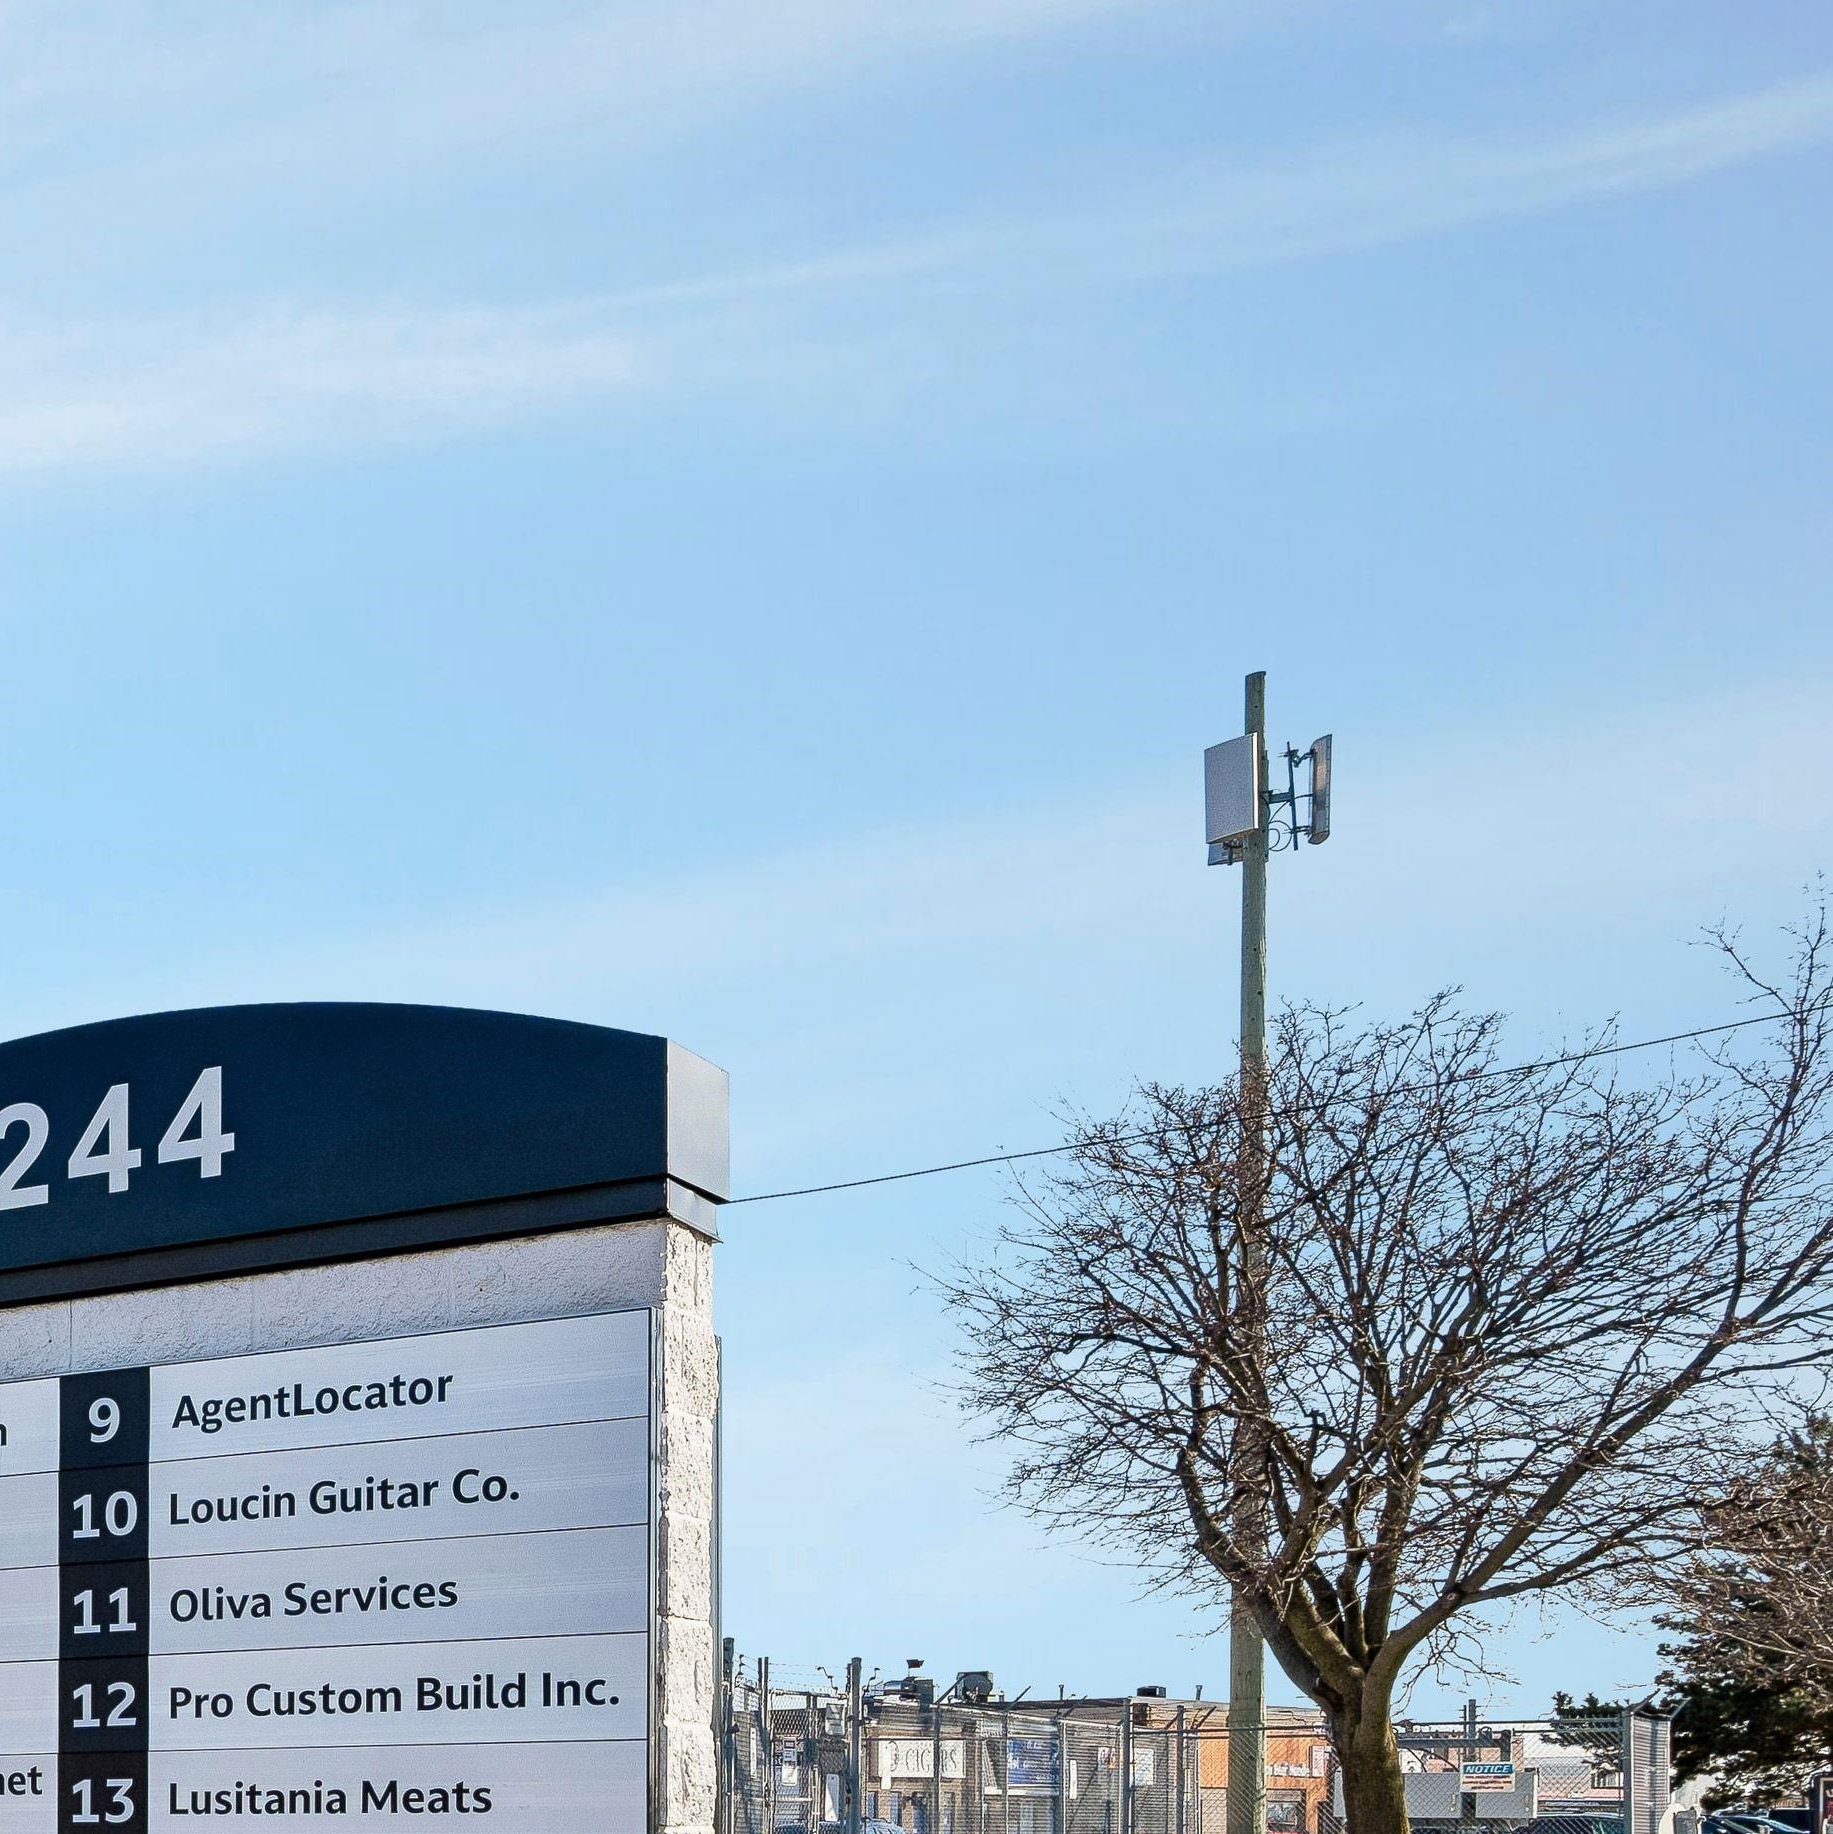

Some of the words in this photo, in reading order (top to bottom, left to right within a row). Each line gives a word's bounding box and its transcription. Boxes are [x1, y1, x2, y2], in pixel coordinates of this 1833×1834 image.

[88, 1397, 120, 1444] 9
[171, 1374, 454, 1434] AgentLocator
[72, 1490, 138, 1539] 10
[170, 1484, 296, 1526] Loucin
[309, 1476, 440, 1515] Guitar
[452, 1468, 520, 1504] Co.
[73, 1587, 137, 1635] 11
[170, 1586, 271, 1623] Oliva
[284, 1575, 458, 1616] Services
[72, 1681, 137, 1729] 12
[170, 1687, 234, 1719] Pro
[246, 1682, 402, 1717] Custom
[416, 1672, 526, 1711] Build
[542, 1672, 620, 1707] Inc.
[905, 1747, 958, 1773] CIGRS
[1464, 1764, 1510, 1774] NOTICE
[72, 1778, 135, 1824] 13
[169, 1779, 347, 1815] Lusitania
[361, 1780, 492, 1814] Meats
